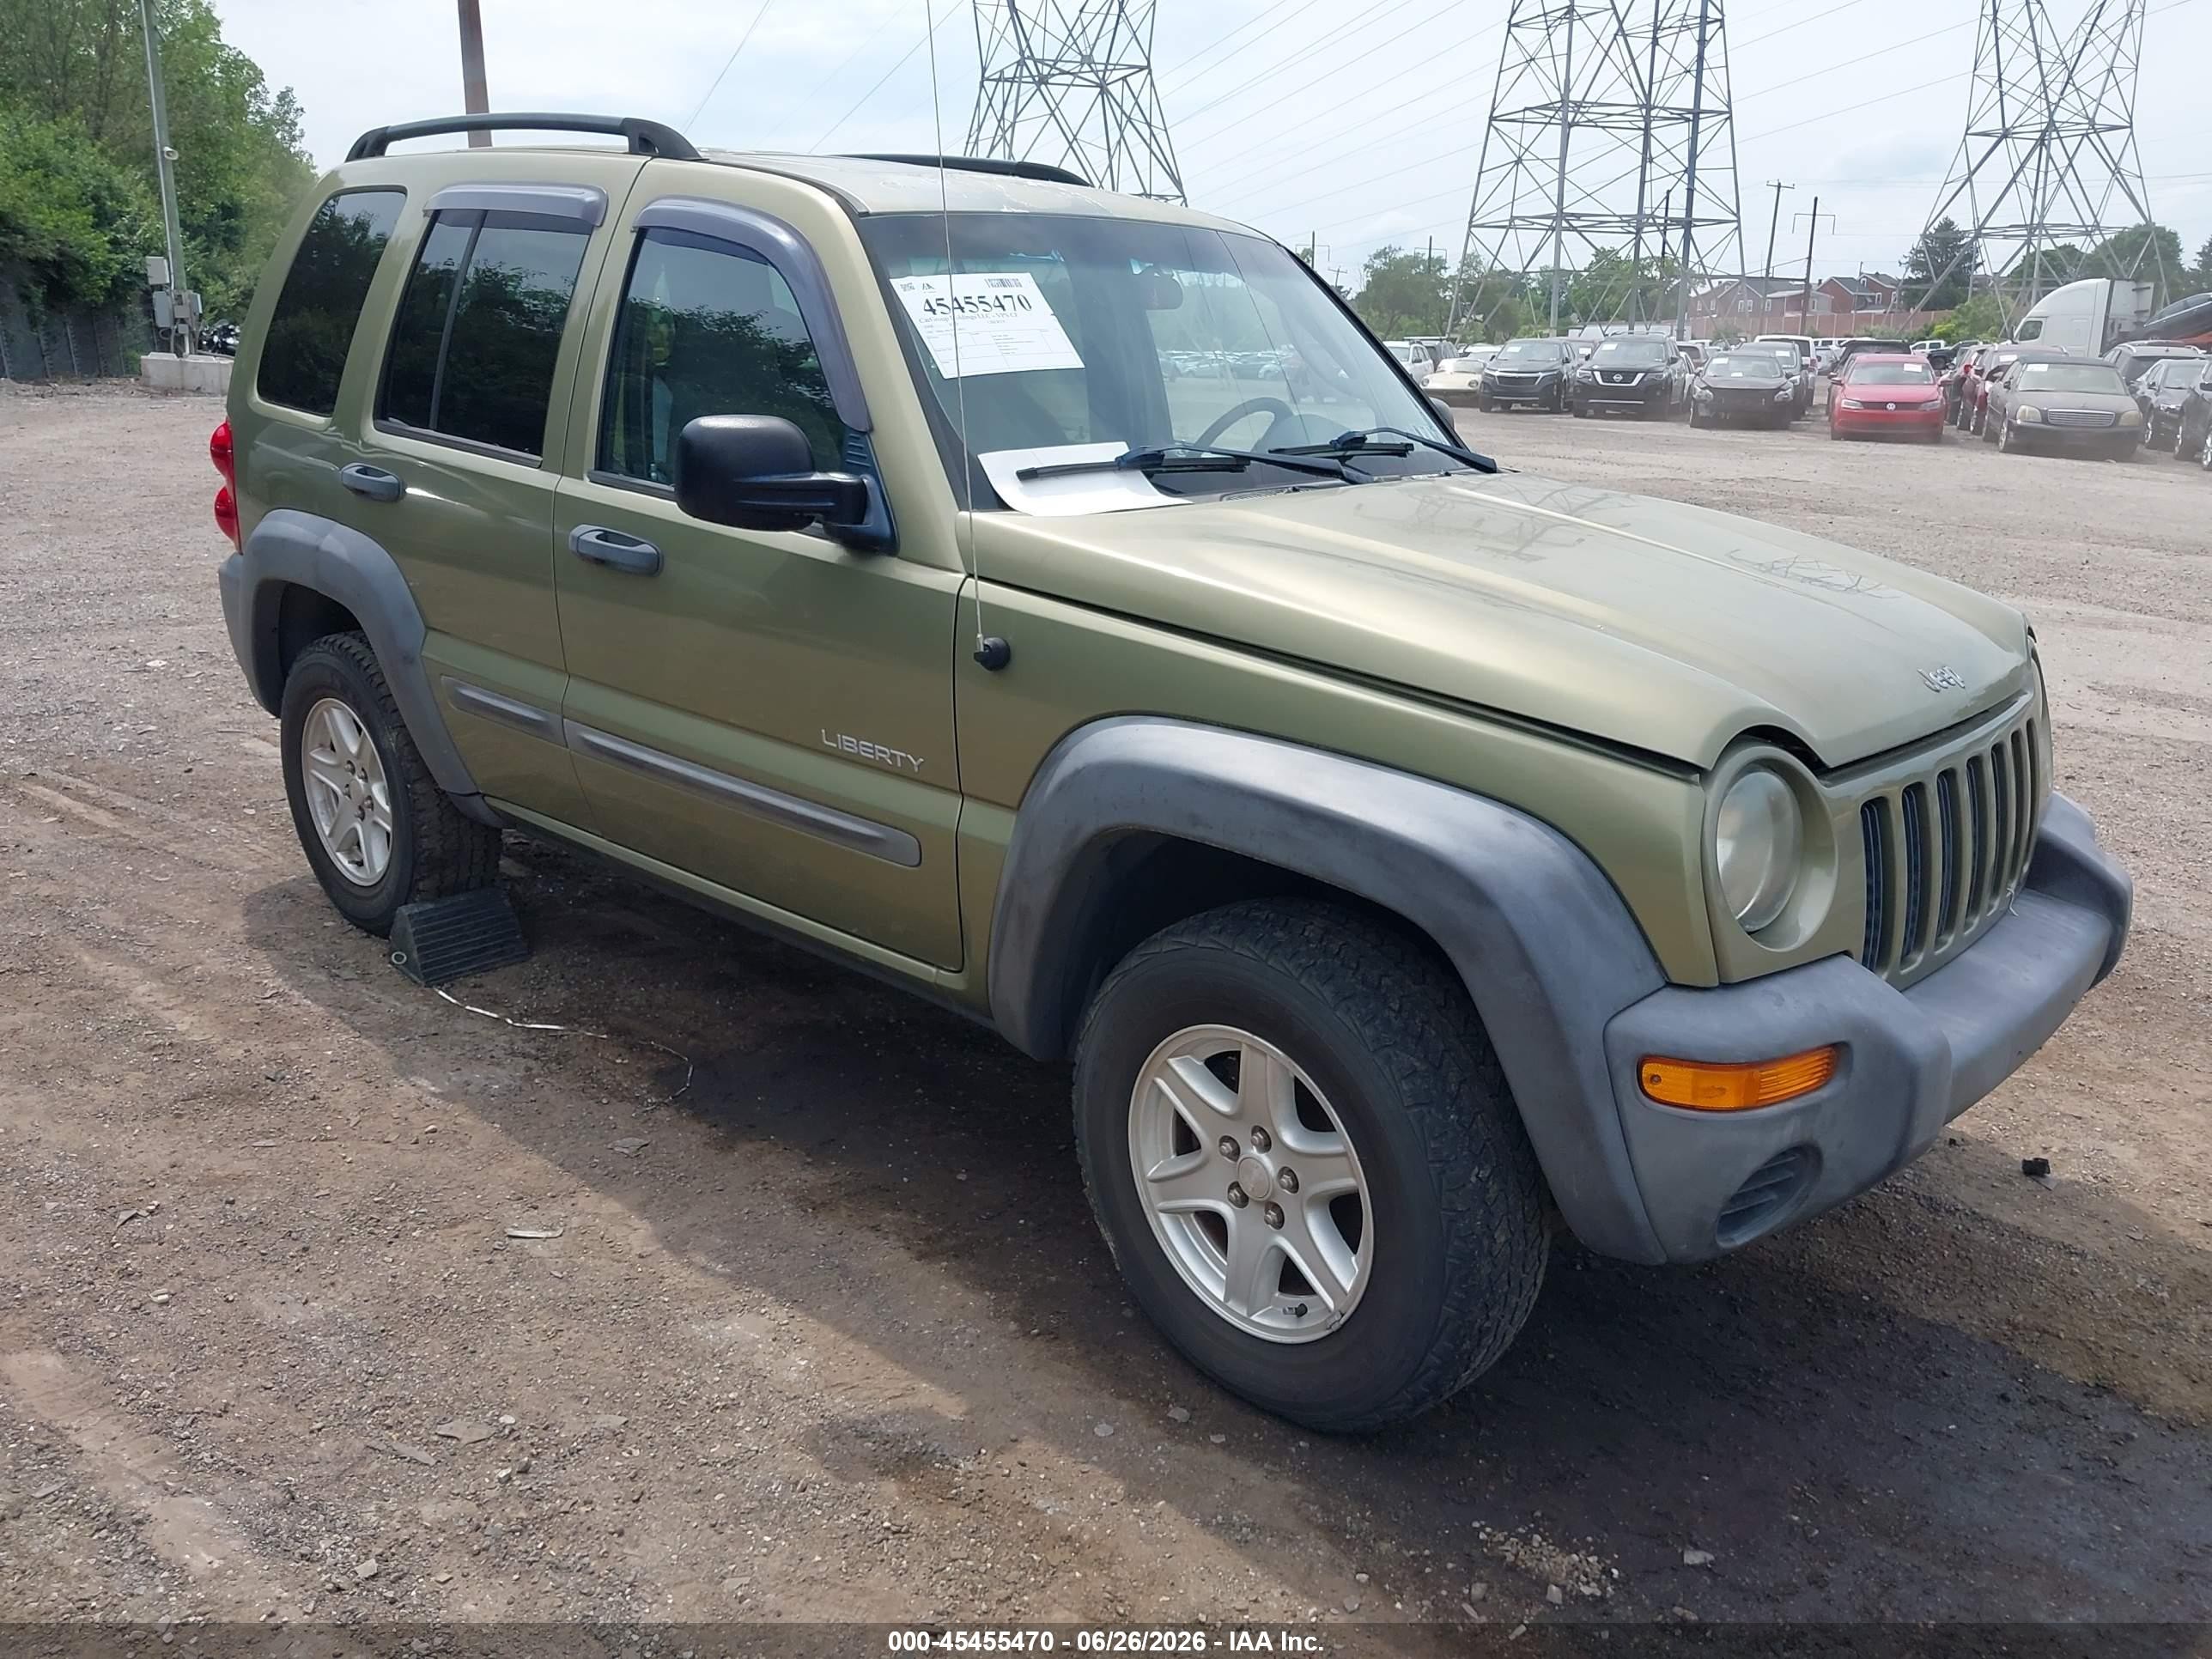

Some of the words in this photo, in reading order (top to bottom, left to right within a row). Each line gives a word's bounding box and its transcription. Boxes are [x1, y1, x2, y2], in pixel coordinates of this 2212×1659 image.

[923, 294, 1032, 315] 45455470
[1917, 666, 1966, 693] Jeep
[821, 728, 924, 772] LIBERTY
